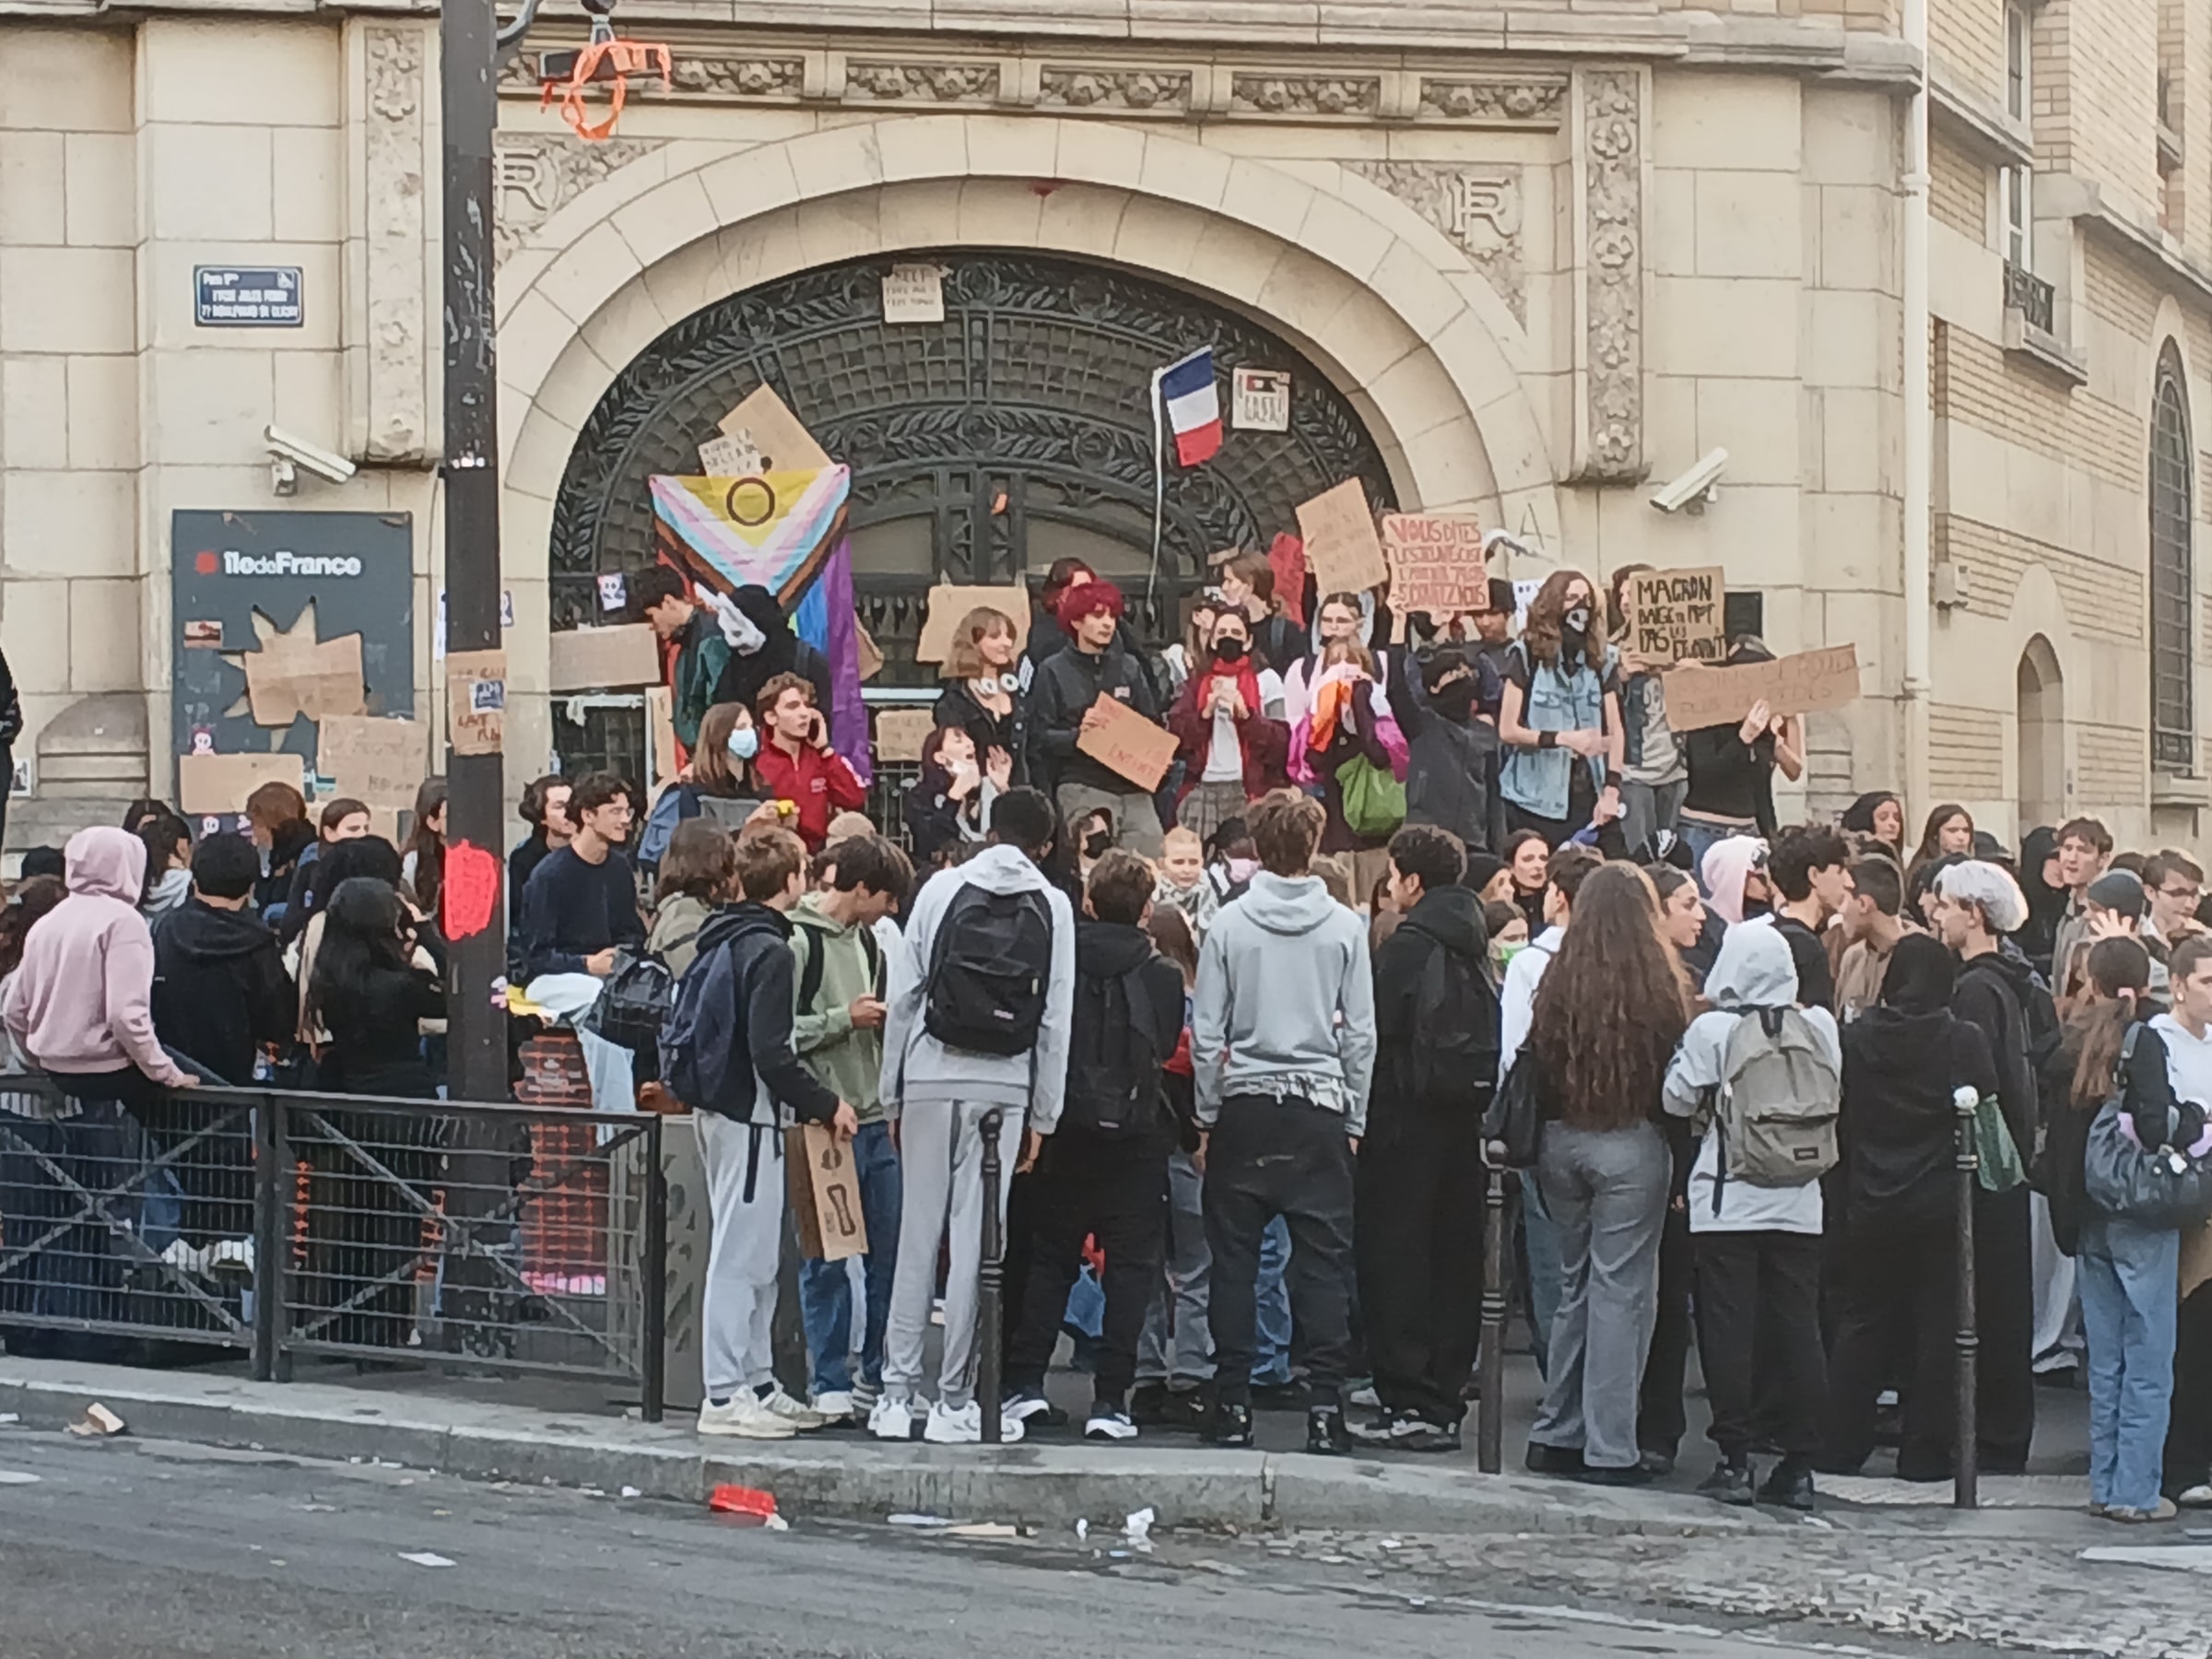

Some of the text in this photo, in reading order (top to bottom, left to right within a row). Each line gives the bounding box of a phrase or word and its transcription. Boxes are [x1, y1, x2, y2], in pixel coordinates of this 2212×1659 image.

[1388, 518, 1441, 543] VOUS
[1637, 575, 1712, 605] MACRON
[1639, 627, 1670, 653] PAS
